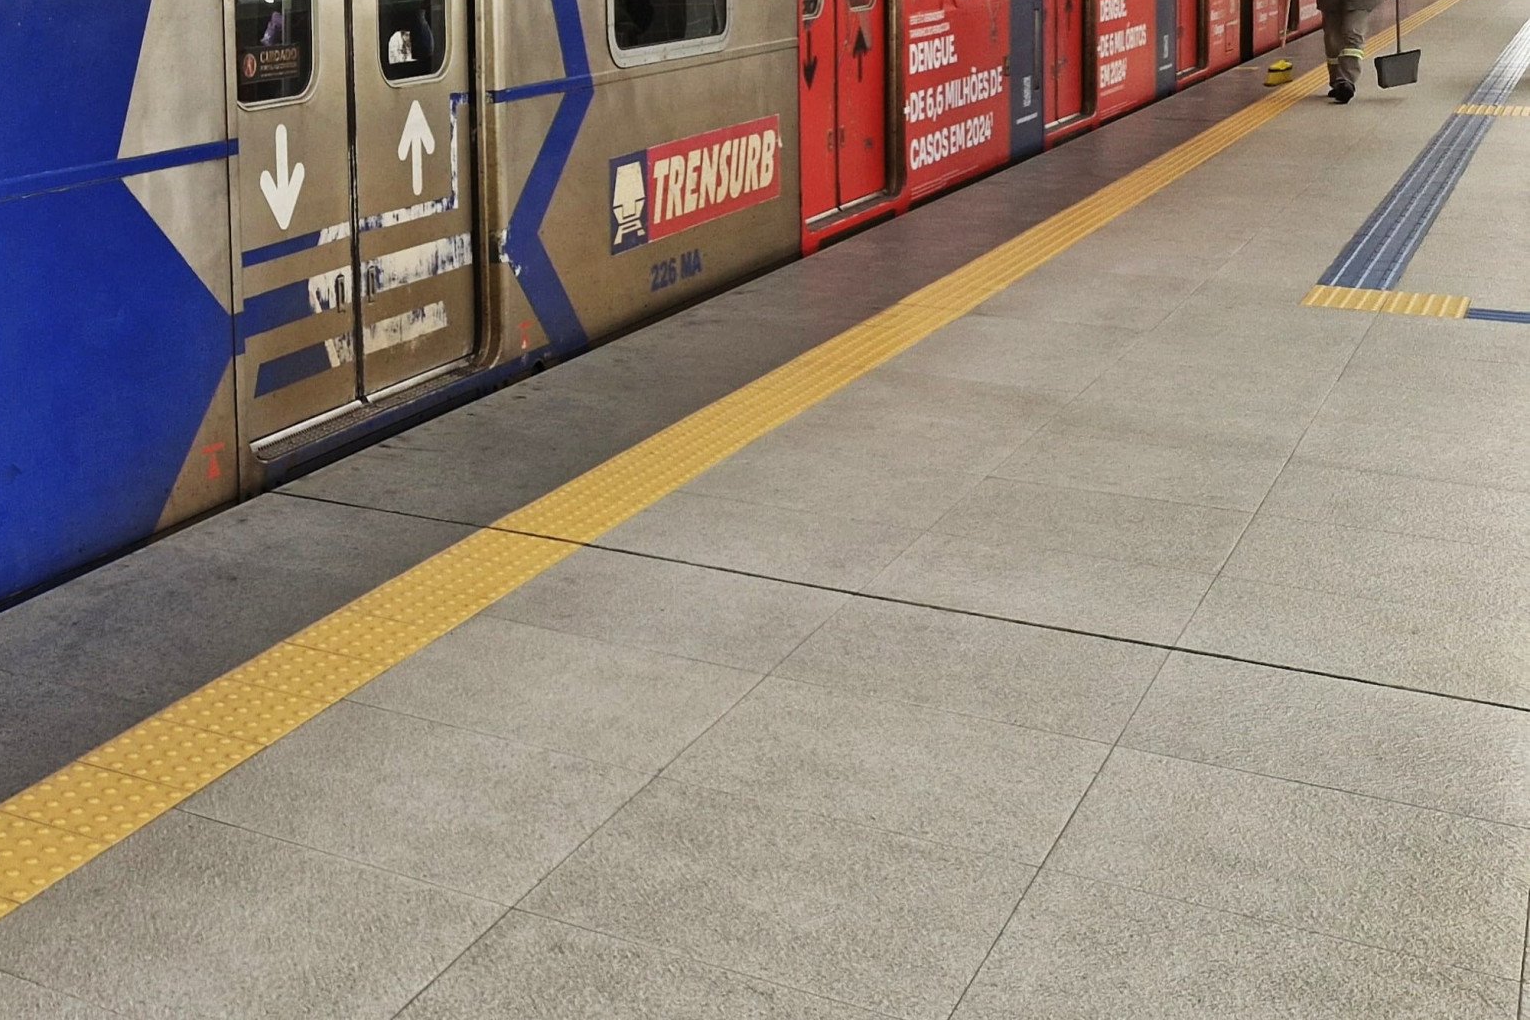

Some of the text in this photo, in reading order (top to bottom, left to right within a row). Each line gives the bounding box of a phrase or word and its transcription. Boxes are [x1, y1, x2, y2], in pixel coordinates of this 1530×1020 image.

[926, 85, 944, 121] 6,6
[944, 66, 989, 111] MILHÕES
[989, 66, 1003, 97] DE
[910, 127, 949, 170] CASOS
[949, 122, 965, 154] EM
[653, 129, 776, 224] TRENSURB
[651, 257, 677, 292] 226
